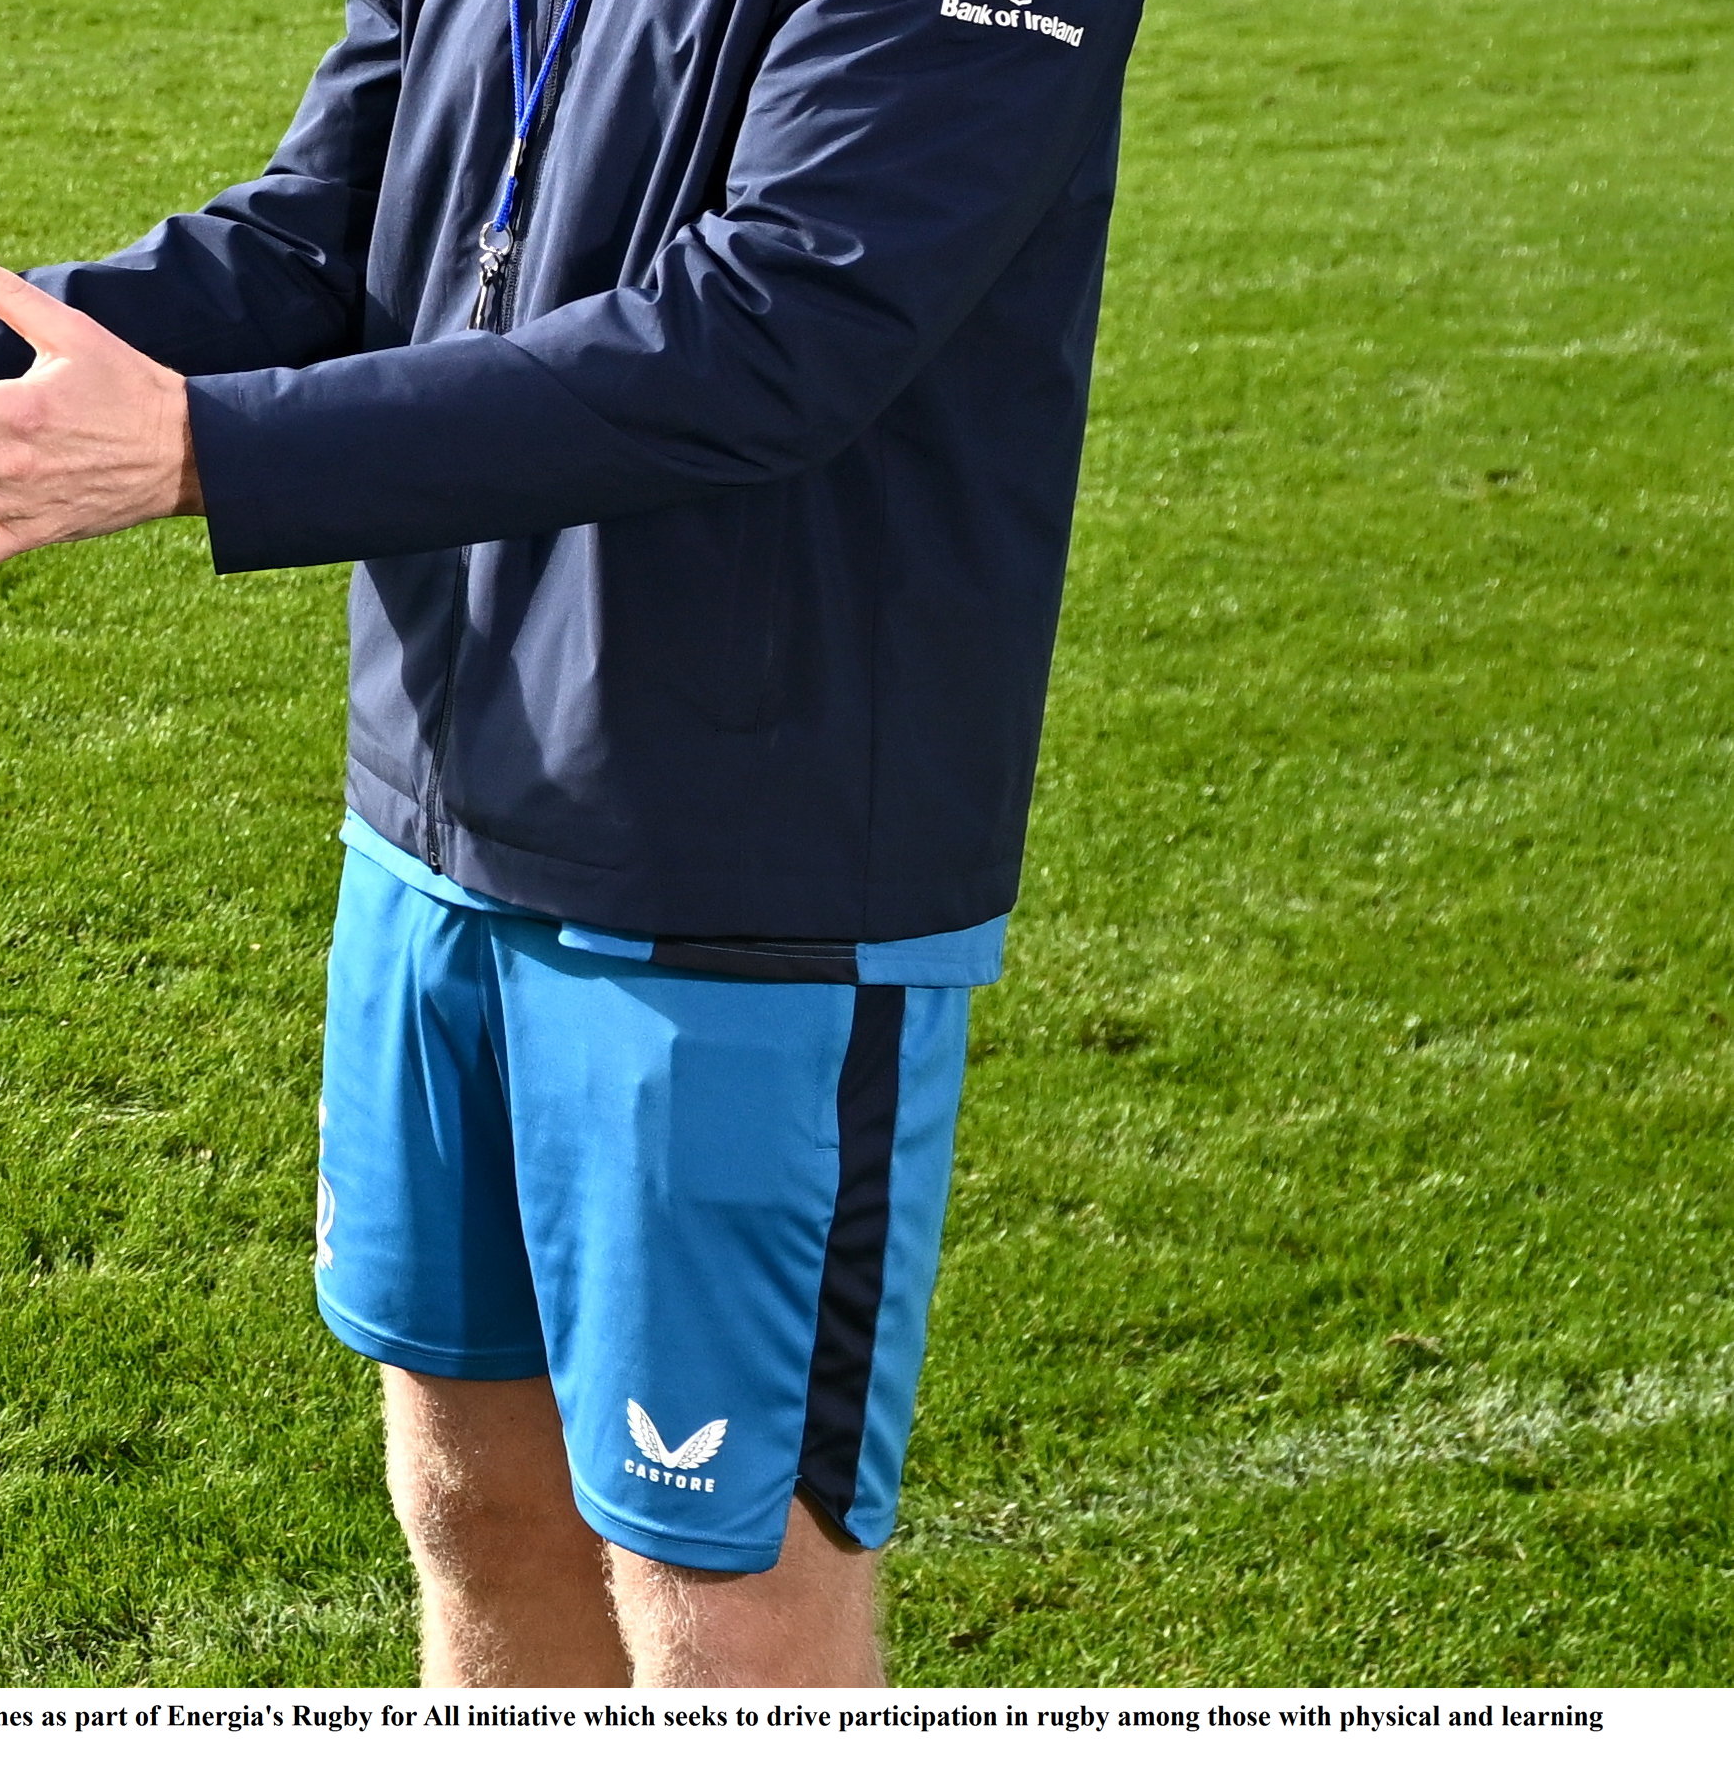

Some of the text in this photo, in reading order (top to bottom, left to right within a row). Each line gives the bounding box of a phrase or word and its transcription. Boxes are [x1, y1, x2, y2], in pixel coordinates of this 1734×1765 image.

[994, 10, 1021, 27] of
[1024, 10, 1084, 47] Ireland
[624, 1459, 715, 1493] CASTORE
